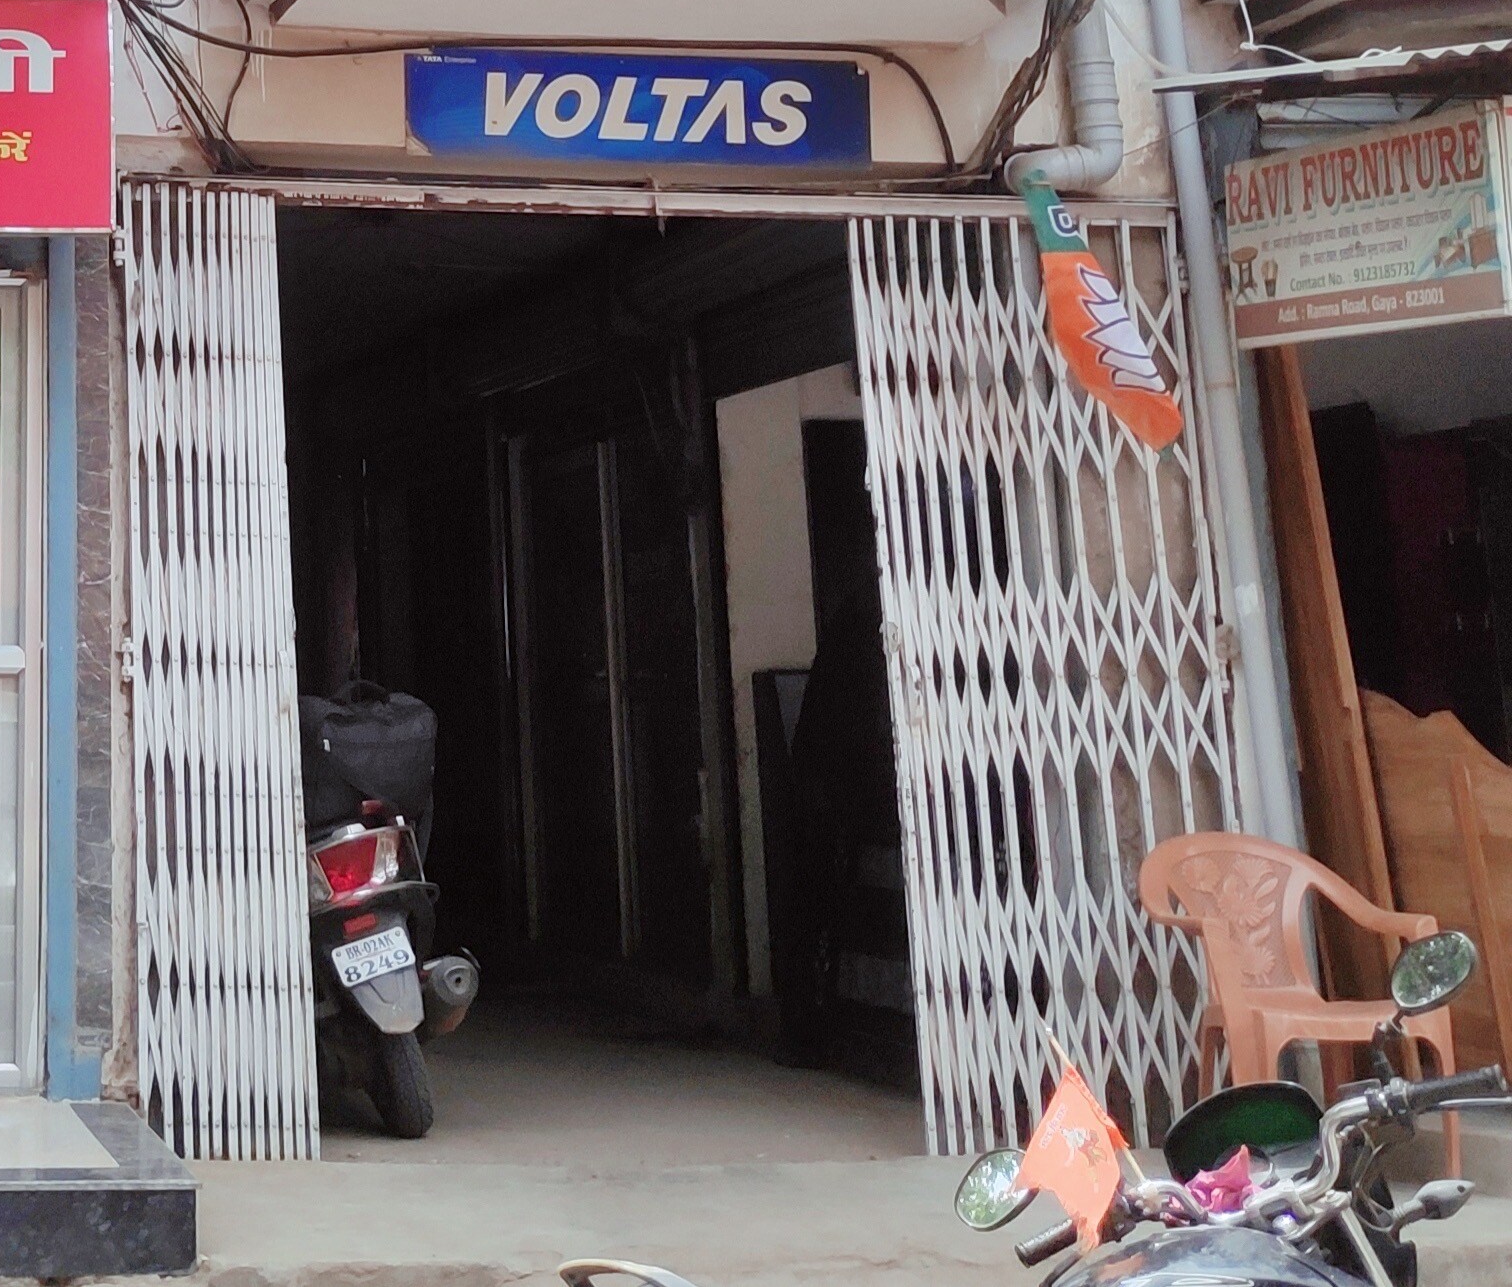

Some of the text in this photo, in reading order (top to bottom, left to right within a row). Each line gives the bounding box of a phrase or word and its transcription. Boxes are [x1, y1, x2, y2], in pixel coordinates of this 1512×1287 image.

[422, 55, 443, 63] TATA
[483, 71, 813, 147] VOLTAS
[1226, 119, 1485, 227] RAVI FURNITURE
[1290, 273, 1326, 292] Contact
[1371, 294, 1398, 313] Gaya
[1405, 287, 1445, 308] 823001
[344, 949, 410, 983] 8249
